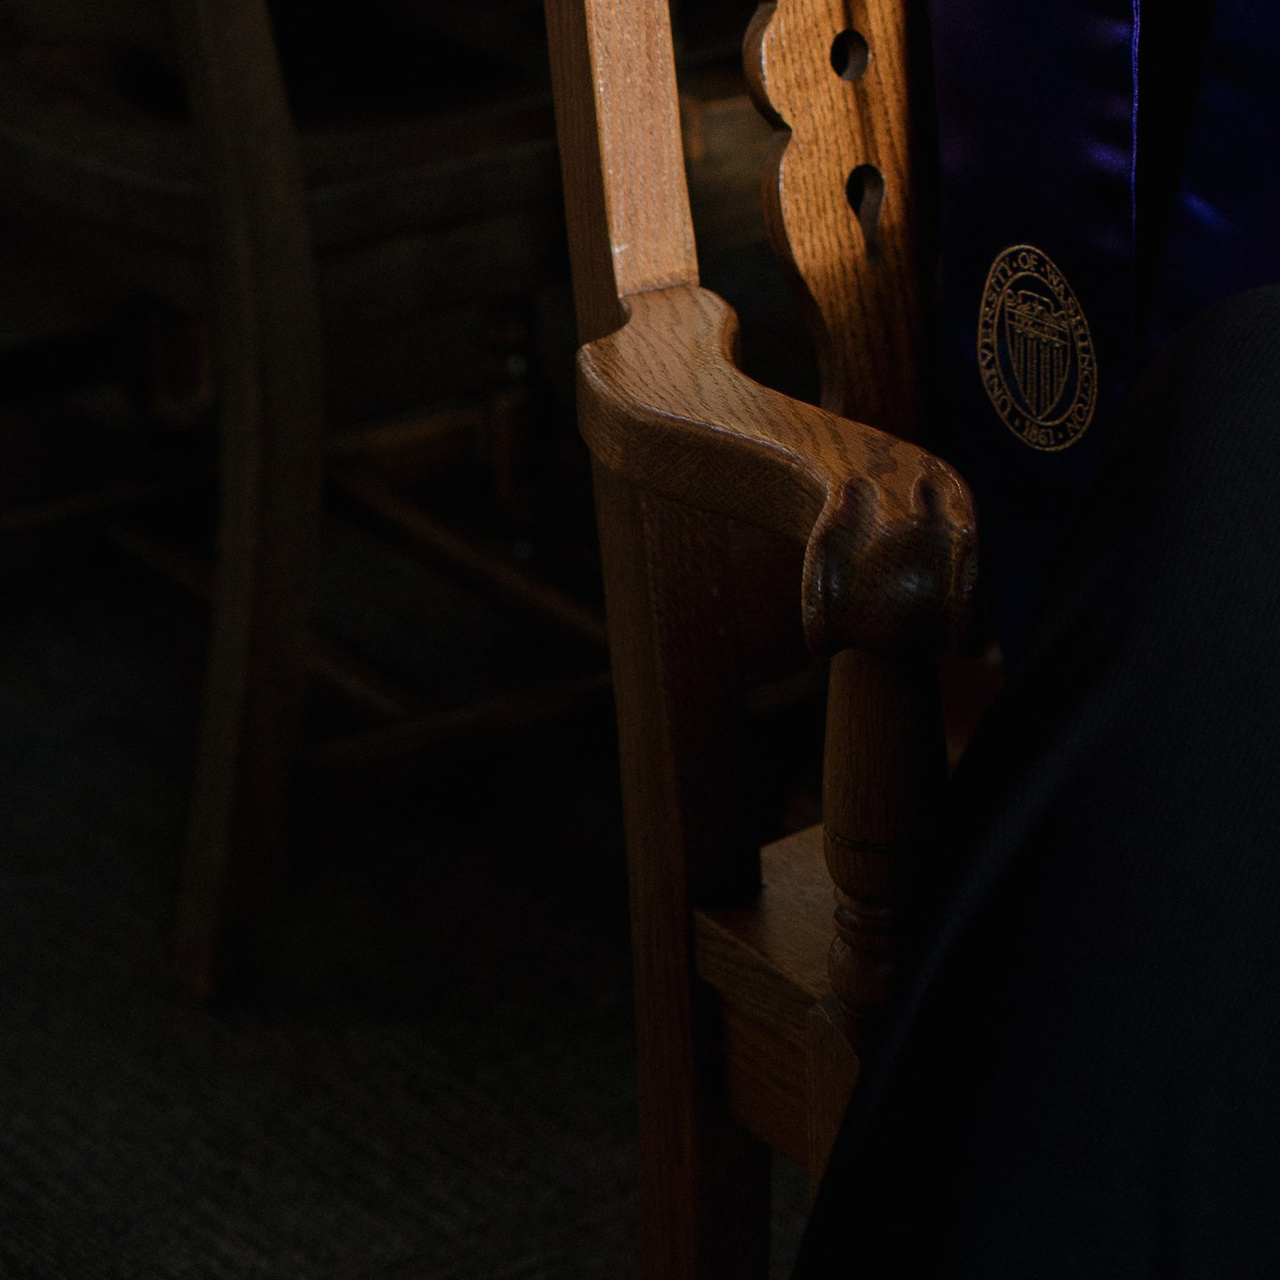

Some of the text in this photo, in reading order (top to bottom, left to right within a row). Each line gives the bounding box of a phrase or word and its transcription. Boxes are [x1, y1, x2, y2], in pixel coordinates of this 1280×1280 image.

[980, 251, 1094, 437] UNIVERSITY OF WASHINGTON
[1021, 420, 1056, 446] 1861
